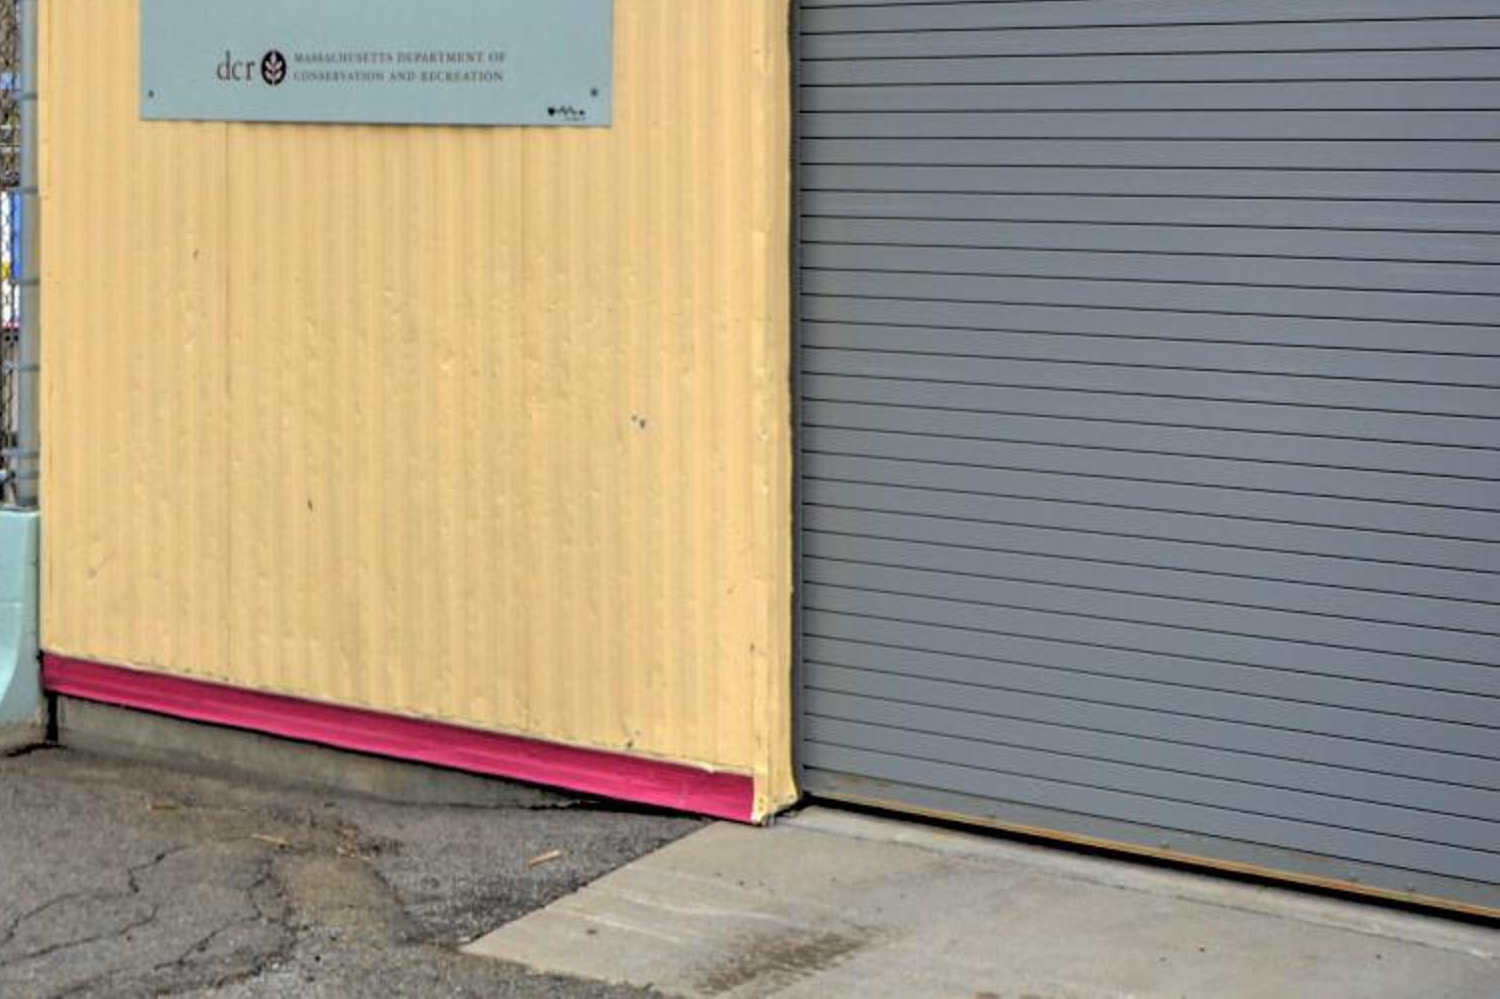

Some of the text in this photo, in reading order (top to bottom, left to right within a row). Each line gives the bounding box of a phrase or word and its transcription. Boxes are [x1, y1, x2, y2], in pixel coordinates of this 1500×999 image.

[397, 51, 485, 64] DEPARTMENT
[488, 51, 506, 64] OF
[216, 50, 255, 81] dcr
[293, 70, 503, 83] CONSERVATION AND RECREATION
